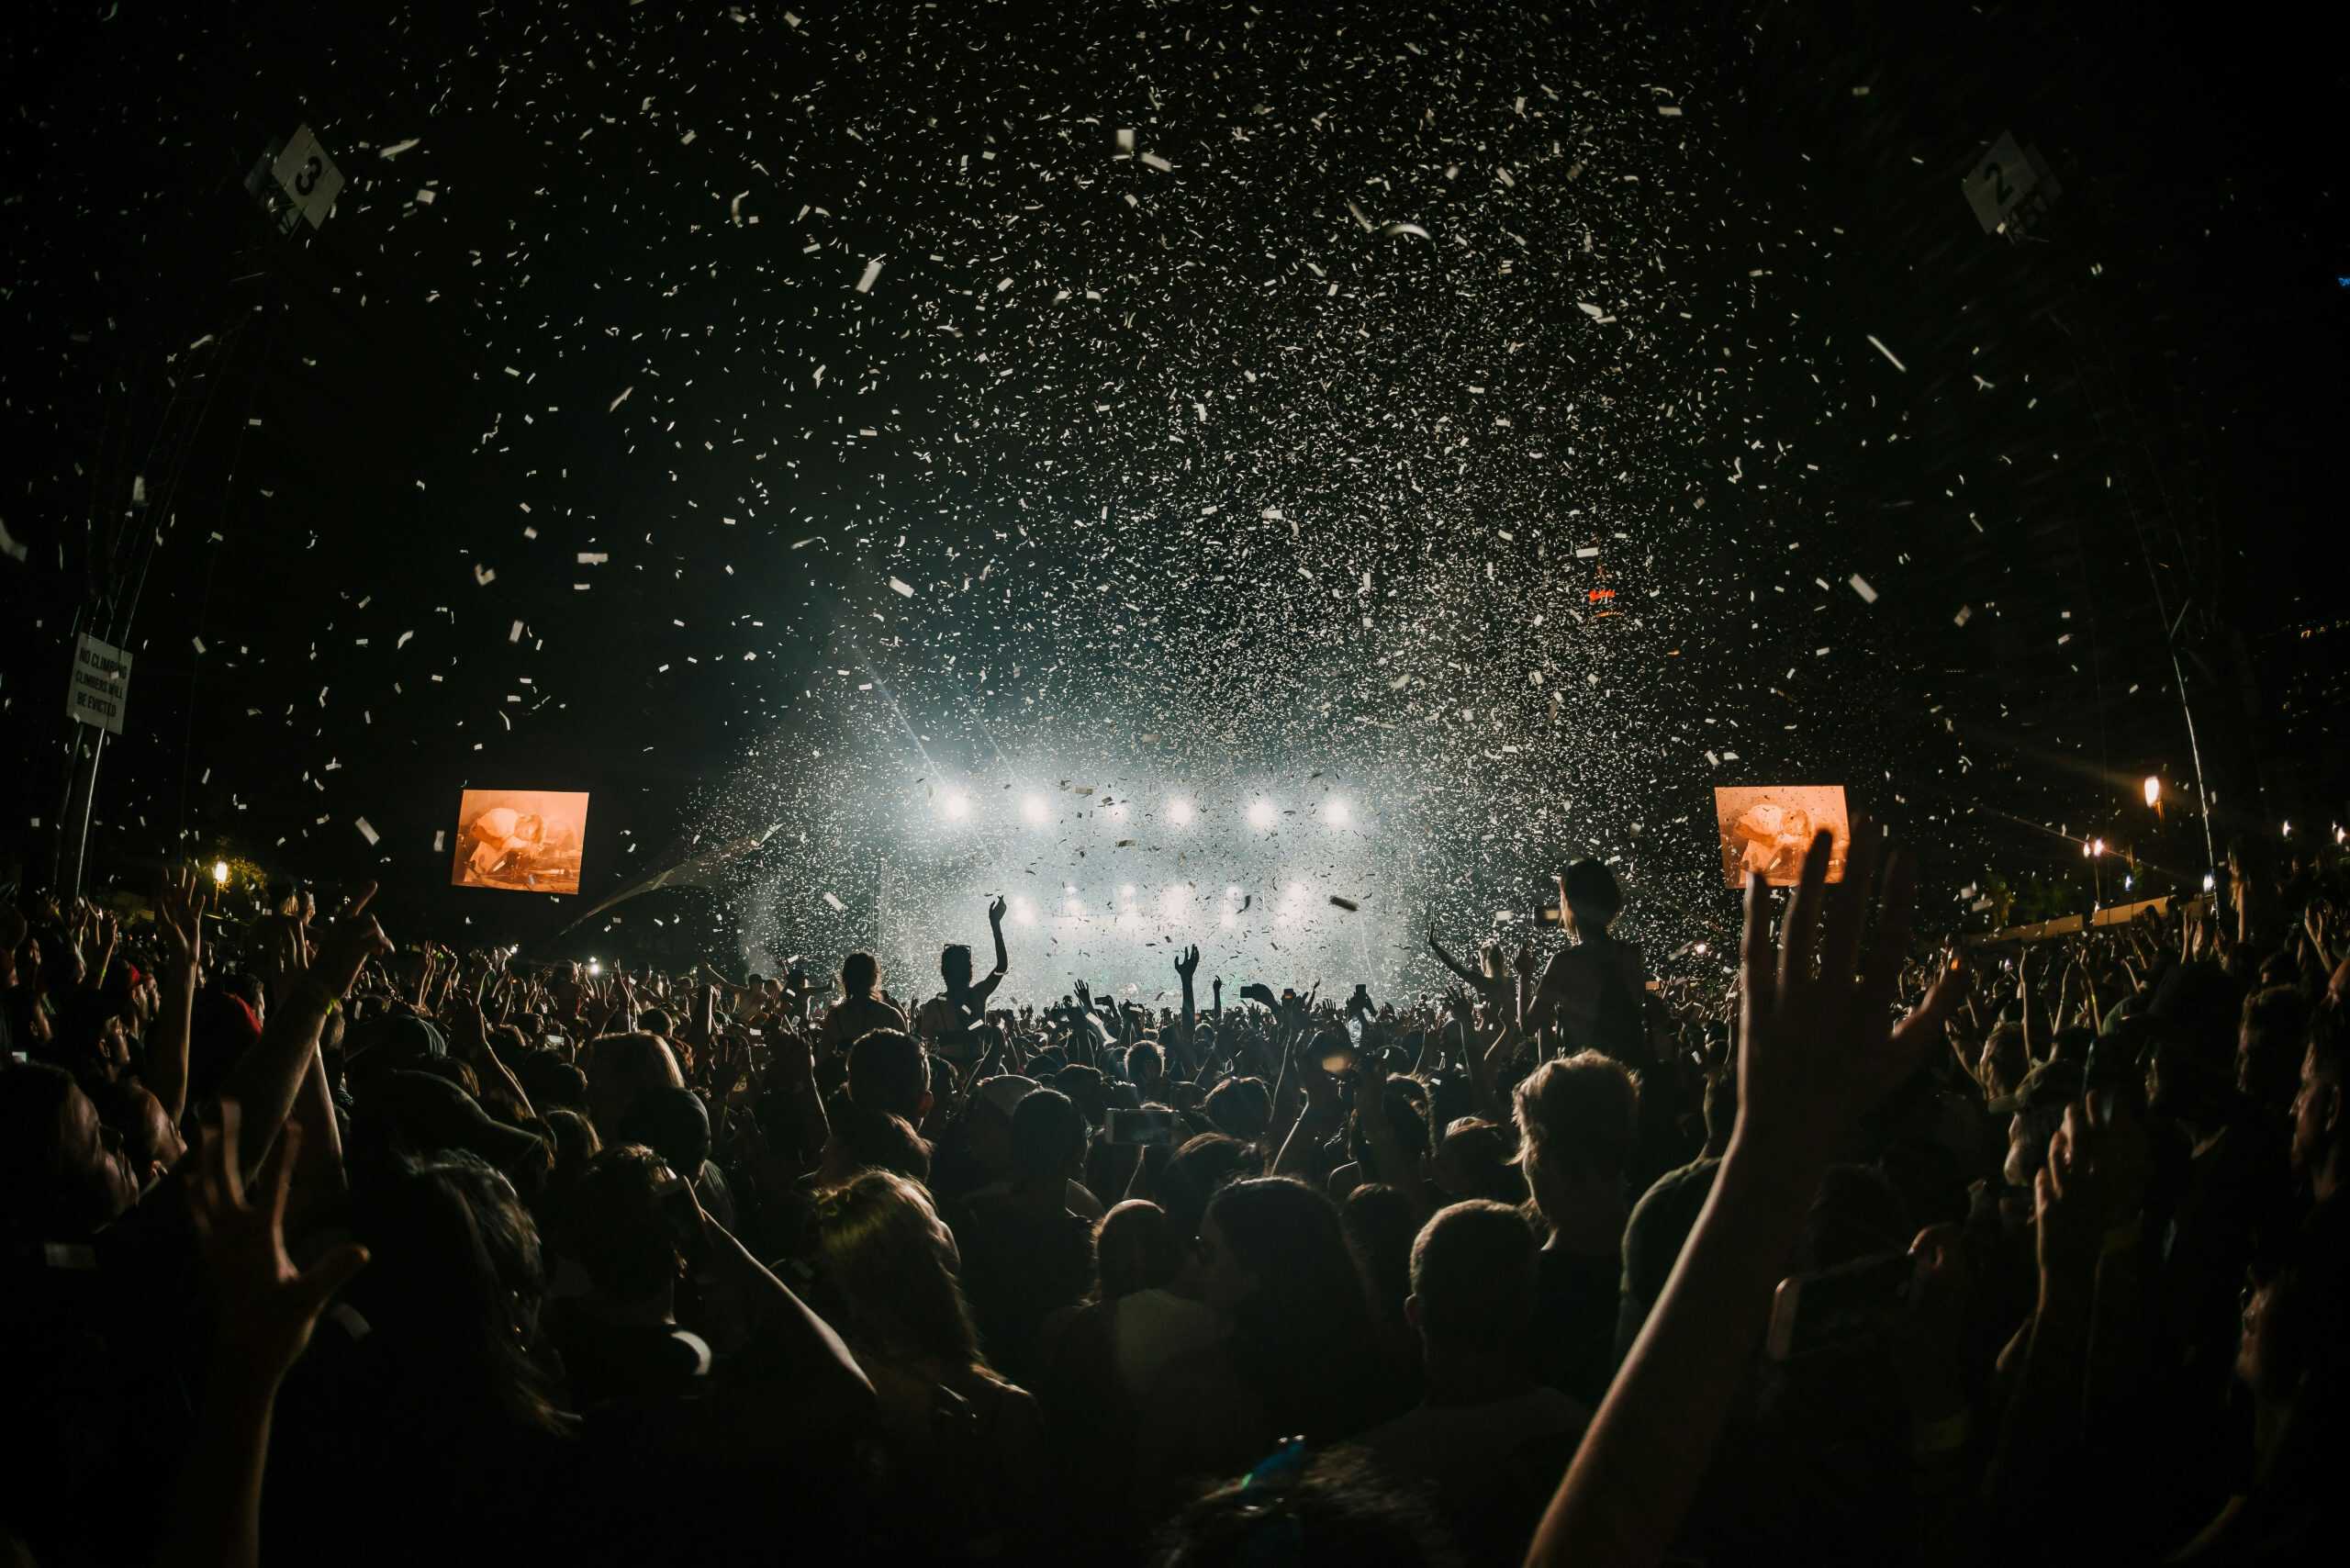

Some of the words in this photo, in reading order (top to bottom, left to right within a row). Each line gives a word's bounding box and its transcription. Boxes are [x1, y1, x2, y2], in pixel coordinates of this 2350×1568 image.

[296, 156, 321, 196] 3
[1984, 162, 2013, 206] 2
[80, 647, 91, 665] NO
[75, 669, 107, 692] CLIMBERS
[77, 691, 87, 707] BE
[88, 695, 117, 717] EVICTED
